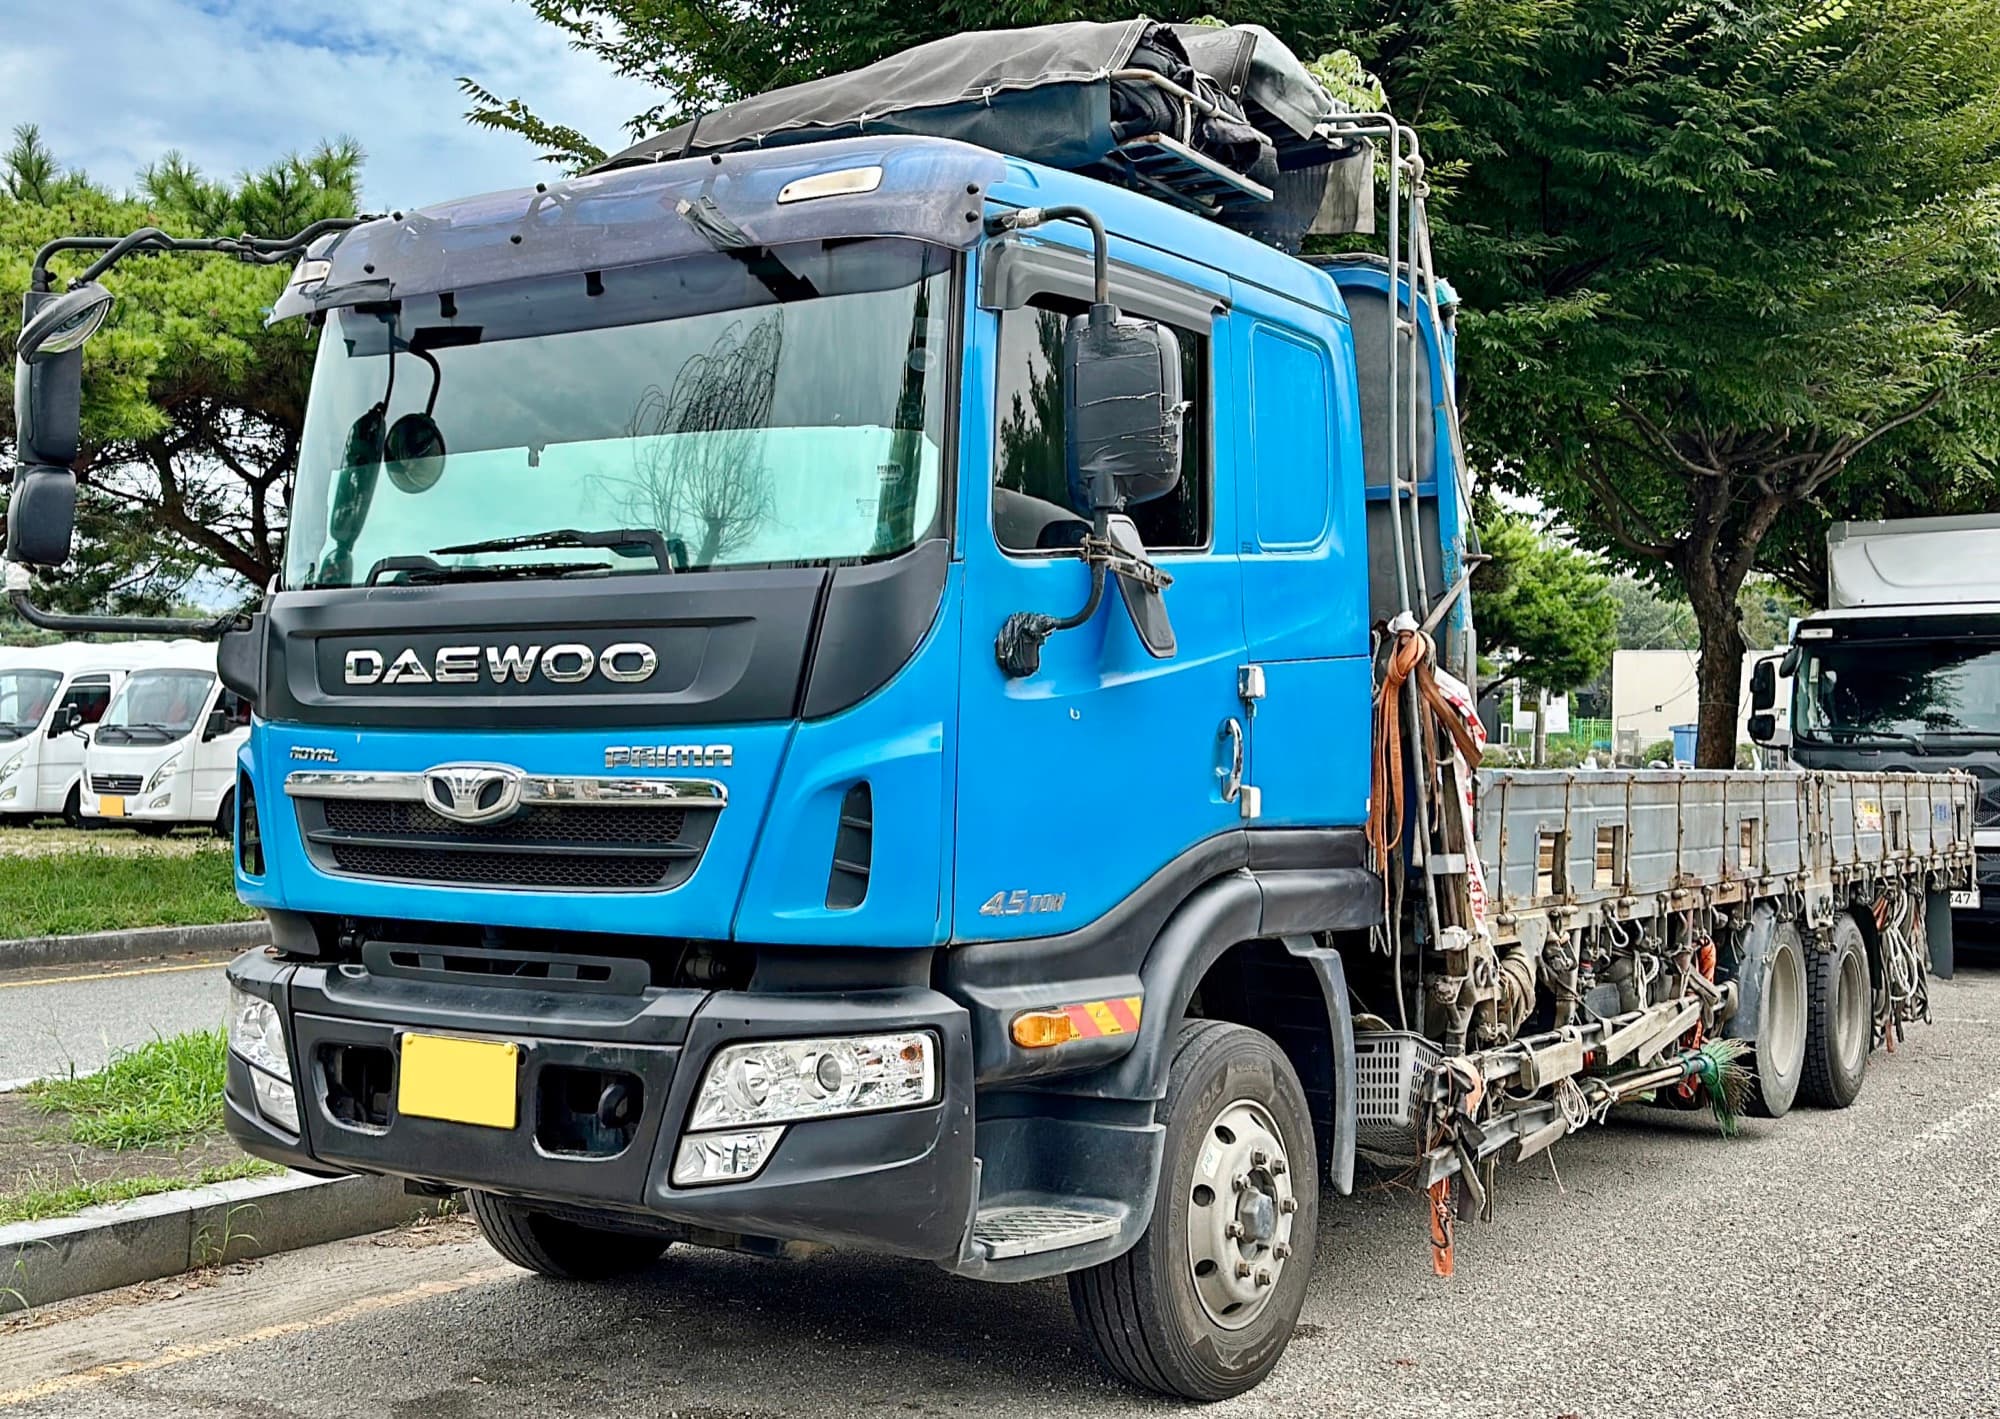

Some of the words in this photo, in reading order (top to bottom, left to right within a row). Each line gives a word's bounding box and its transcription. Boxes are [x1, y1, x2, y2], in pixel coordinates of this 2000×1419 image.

[344, 642, 658, 684] DAEWOO
[289, 745, 339, 762] ROYAL
[604, 744, 733, 768] PRIMA
[979, 889, 1029, 916] 4.5
